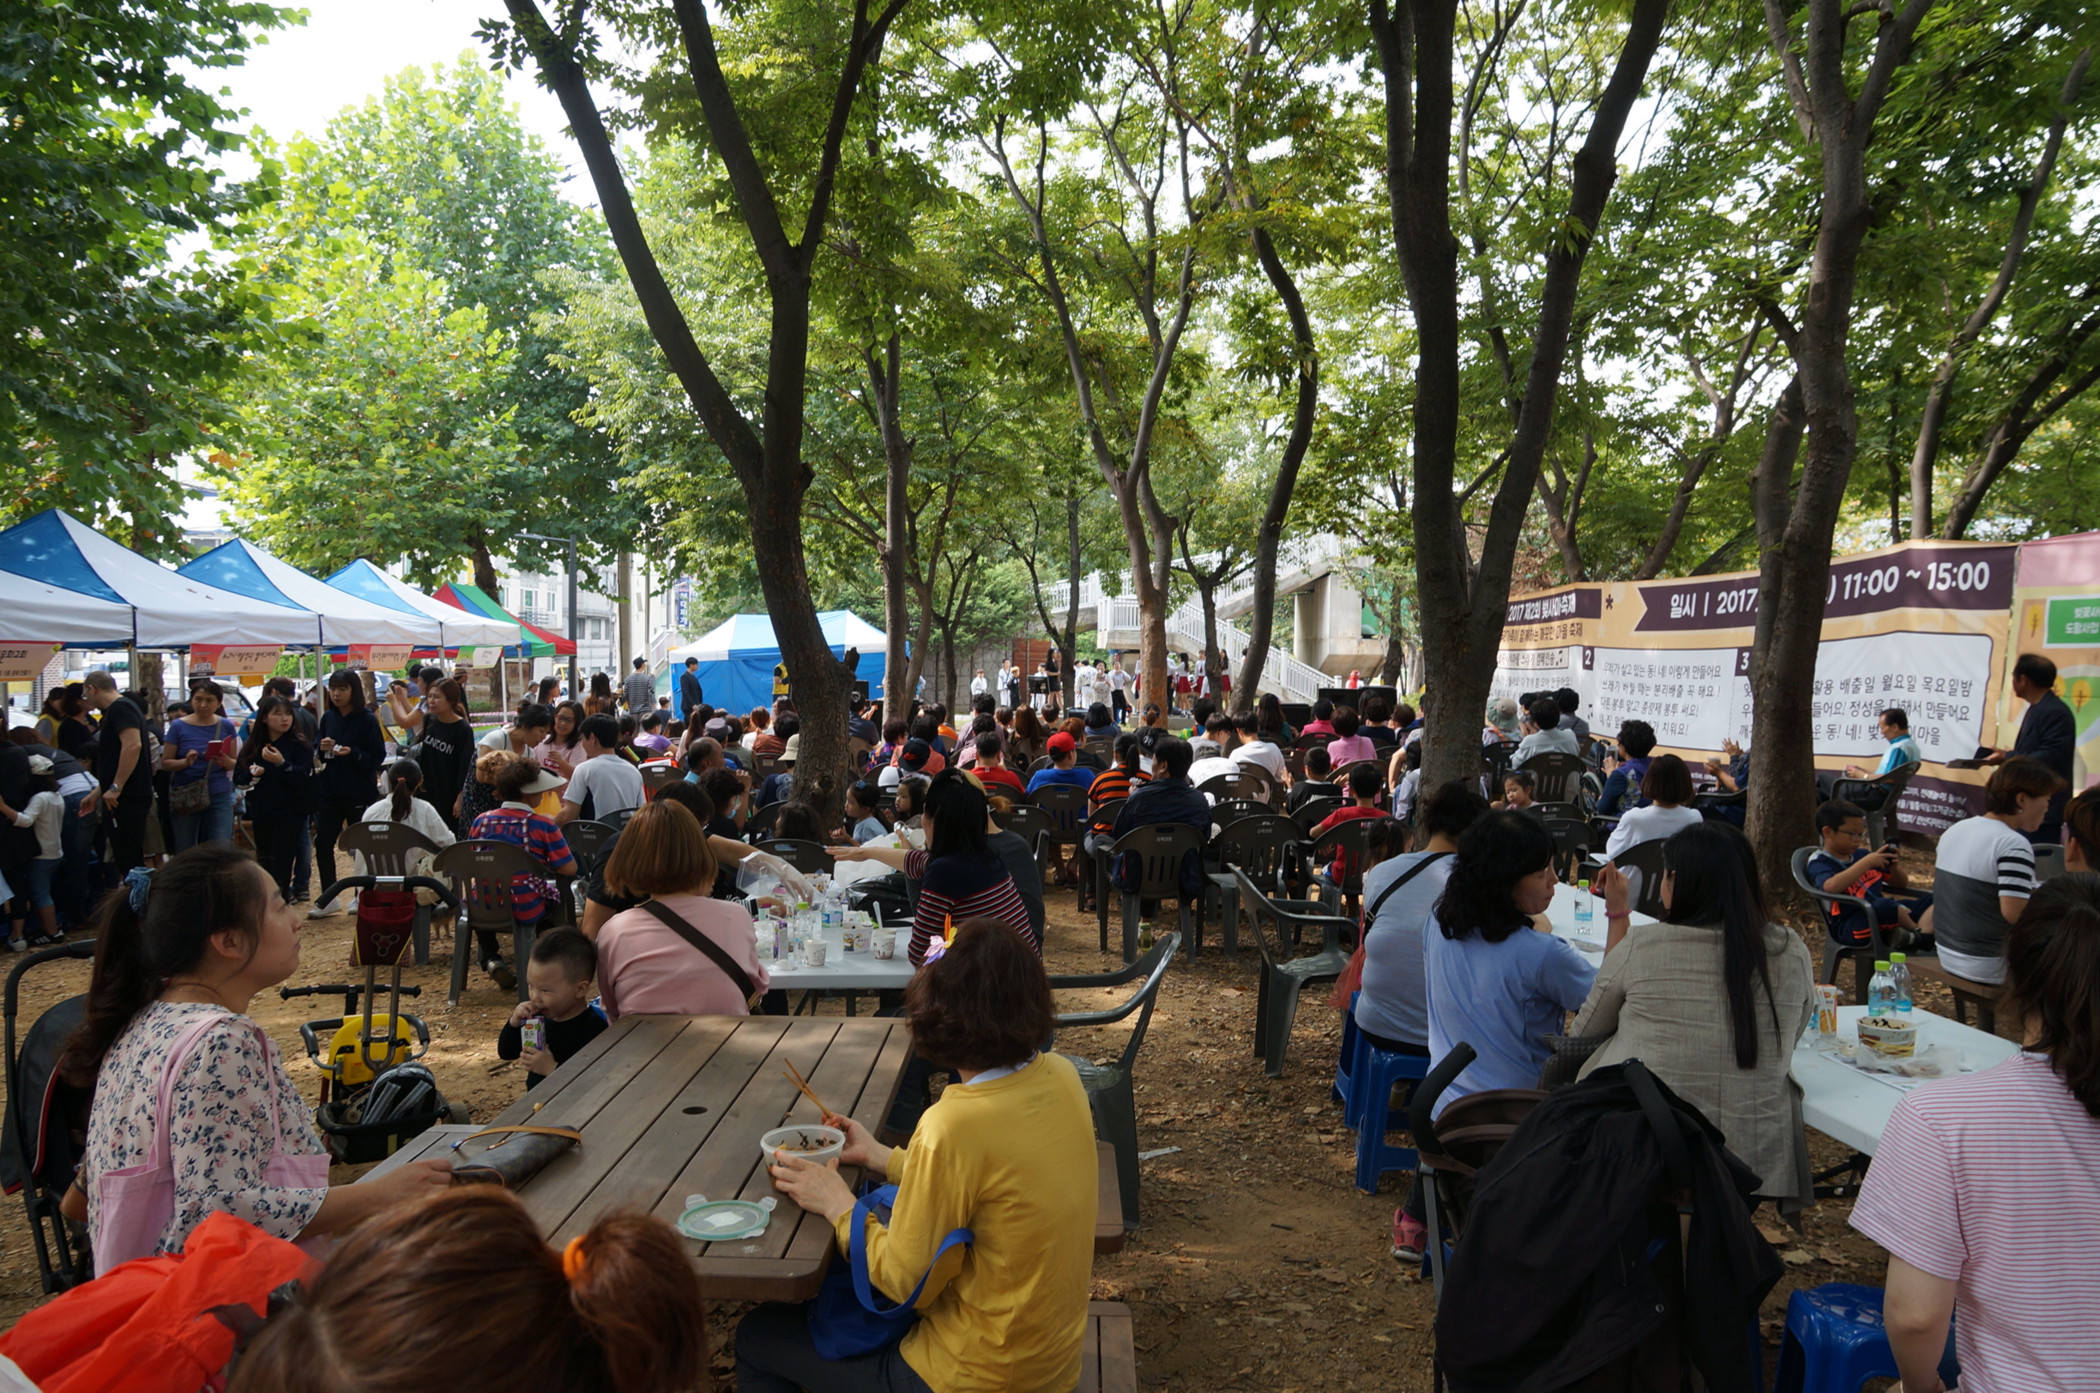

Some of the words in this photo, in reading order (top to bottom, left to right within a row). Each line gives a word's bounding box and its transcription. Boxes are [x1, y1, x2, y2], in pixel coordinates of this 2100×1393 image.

[1670, 591, 1697, 619] 일시
[1842, 565, 1900, 600] 11:00
[1926, 560, 1990, 591] 15:00
[1507, 604, 1523, 622] 2017
[1524, 600, 1541, 620] 제2회
[1569, 622, 1583, 637] 축제
[1584, 649, 1592, 665] 2
[1740, 652, 1750, 670] 3
[1602, 662, 1620, 675] 우리가
[1633, 665, 1646, 678] 있는
[1668, 665, 1691, 680] 이렇게
[1692, 665, 1721, 680] 만들어요
[1601, 680, 1620, 693] 쓰레기
[1622, 682, 1636, 695] 버릴
[1637, 683, 1651, 697] 때는
[1653, 684, 1684, 698] 분리배출
[1686, 685, 1695, 699] 꼭
[1839, 676, 1876, 694] 배출일
[1881, 673, 1917, 692] 월요일
[1612, 698, 1624, 712] 봉투
[1626, 700, 1639, 714] 말고
[1641, 701, 1662, 715] 종량제
[1664, 702, 1679, 717] 봉투
[1681, 703, 1699, 718] 써요!
[1849, 699, 1885, 718] 정성을
[1926, 701, 1971, 722] 만들어요
[1662, 721, 1689, 737] 치워요!
[1826, 723, 1842, 740] 동!
[1845, 724, 1862, 740] 네!
